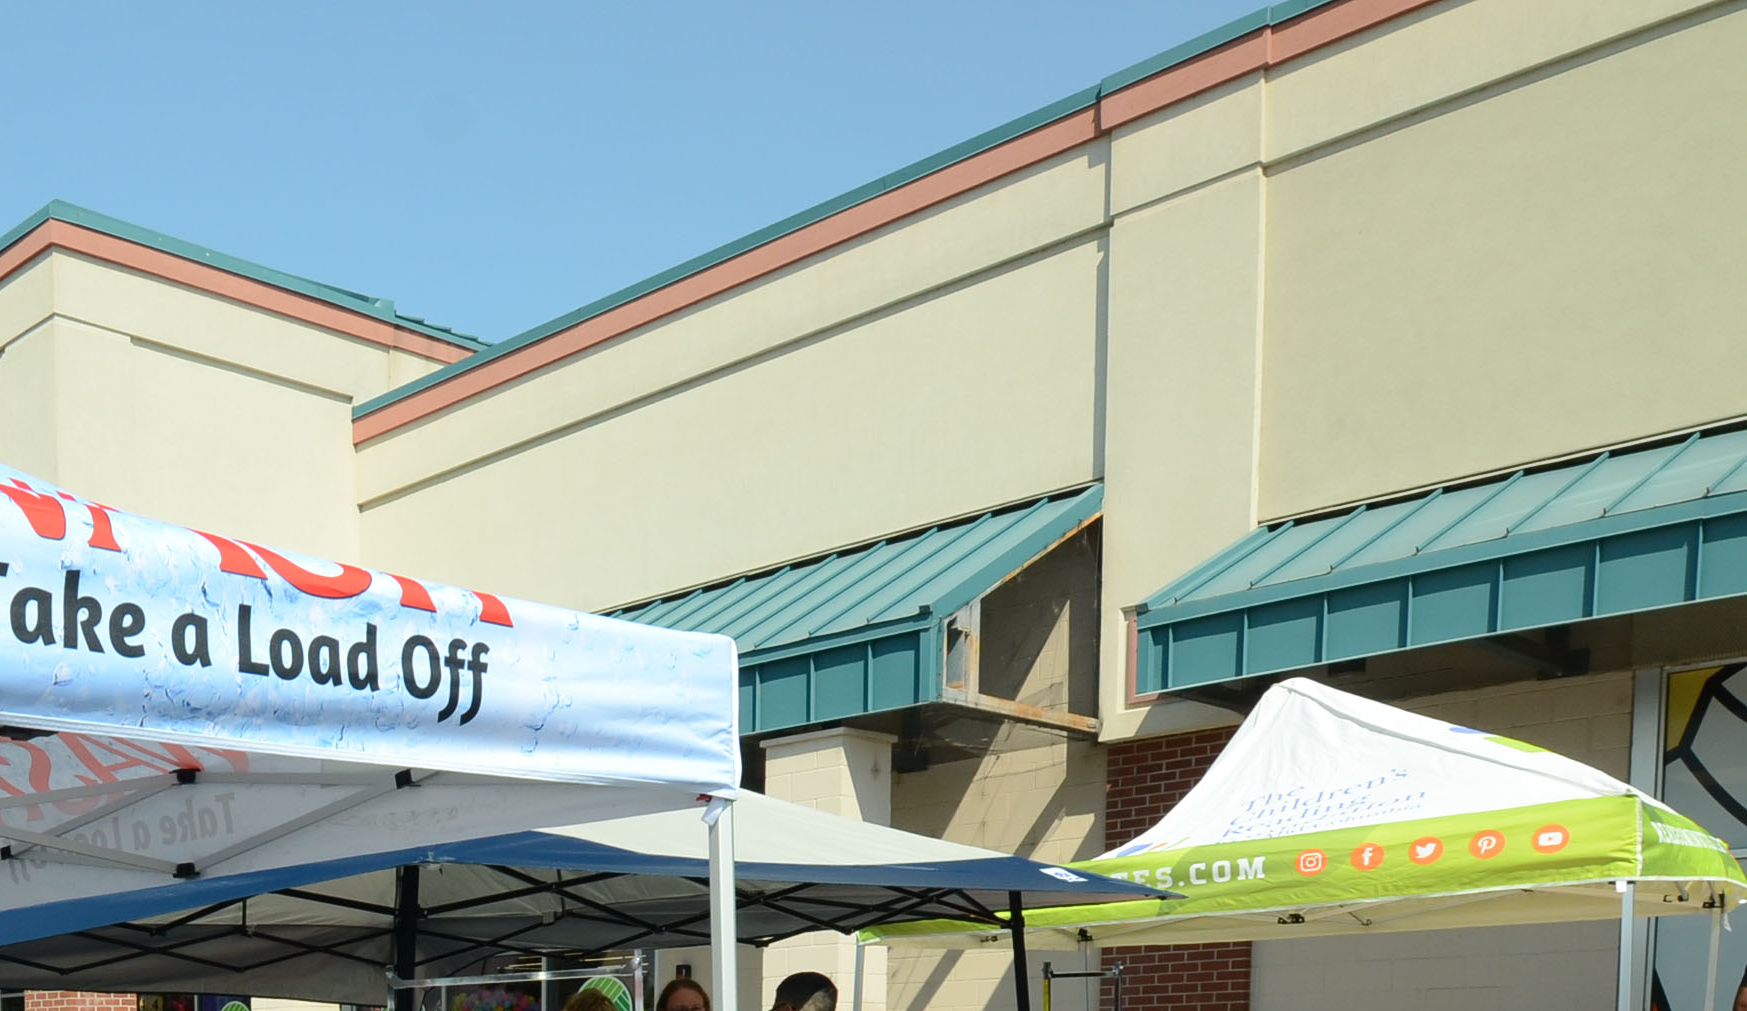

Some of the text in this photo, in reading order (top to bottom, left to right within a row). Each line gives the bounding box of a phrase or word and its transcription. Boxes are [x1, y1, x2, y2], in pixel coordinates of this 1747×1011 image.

[171, 612, 211, 667] a
[238, 603, 380, 693] Load
[401, 634, 490, 724] Off
